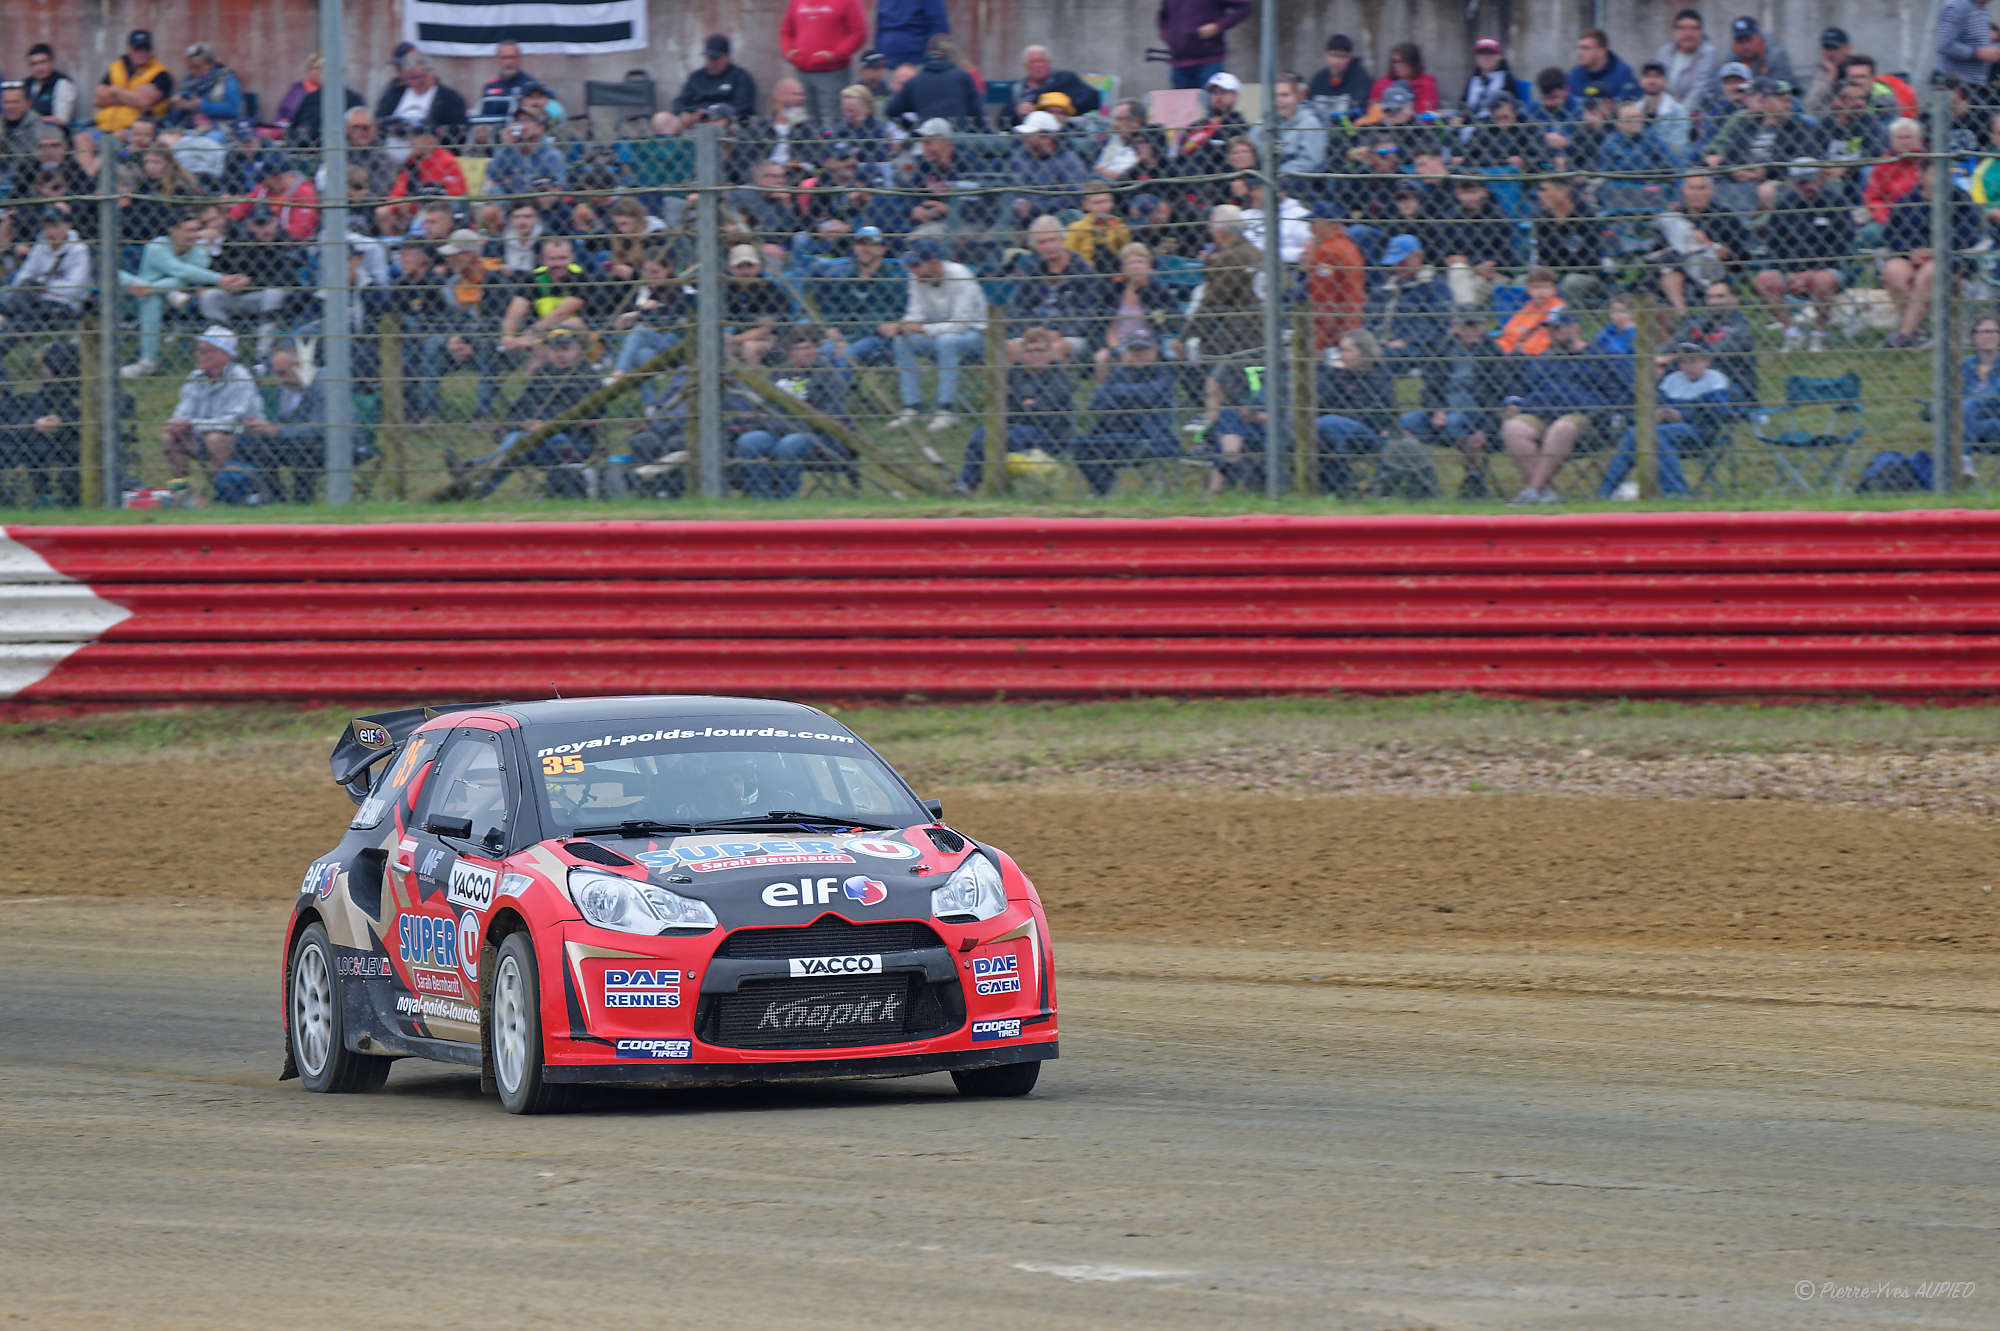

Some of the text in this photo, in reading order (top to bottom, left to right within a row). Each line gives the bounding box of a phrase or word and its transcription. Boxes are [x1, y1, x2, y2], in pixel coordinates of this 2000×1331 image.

[360, 728, 376, 743] elf
[537, 727, 854, 758] noyal-poids-lourds.com
[541, 754, 585, 775] 35
[635, 839, 844, 867] SUPER
[701, 853, 844, 871] Sarah Bernhardt
[301, 863, 328, 894] elf
[453, 870, 491, 904] YACCO
[762, 877, 839, 907] elf
[399, 913, 460, 968] SUPER
[799, 956, 874, 974] YACCO
[974, 955, 1018, 975] DAF
[416, 973, 460, 994] Sarah Bernhardt
[605, 970, 681, 987] DAF
[977, 979, 1021, 995] CAEN
[605, 993, 680, 1007] RENNES
[973, 1020, 1021, 1033] COOPER
[997, 1029, 1020, 1038] TIRES
[617, 1040, 691, 1051] COOPER
[651, 1049, 689, 1058] TIRES
